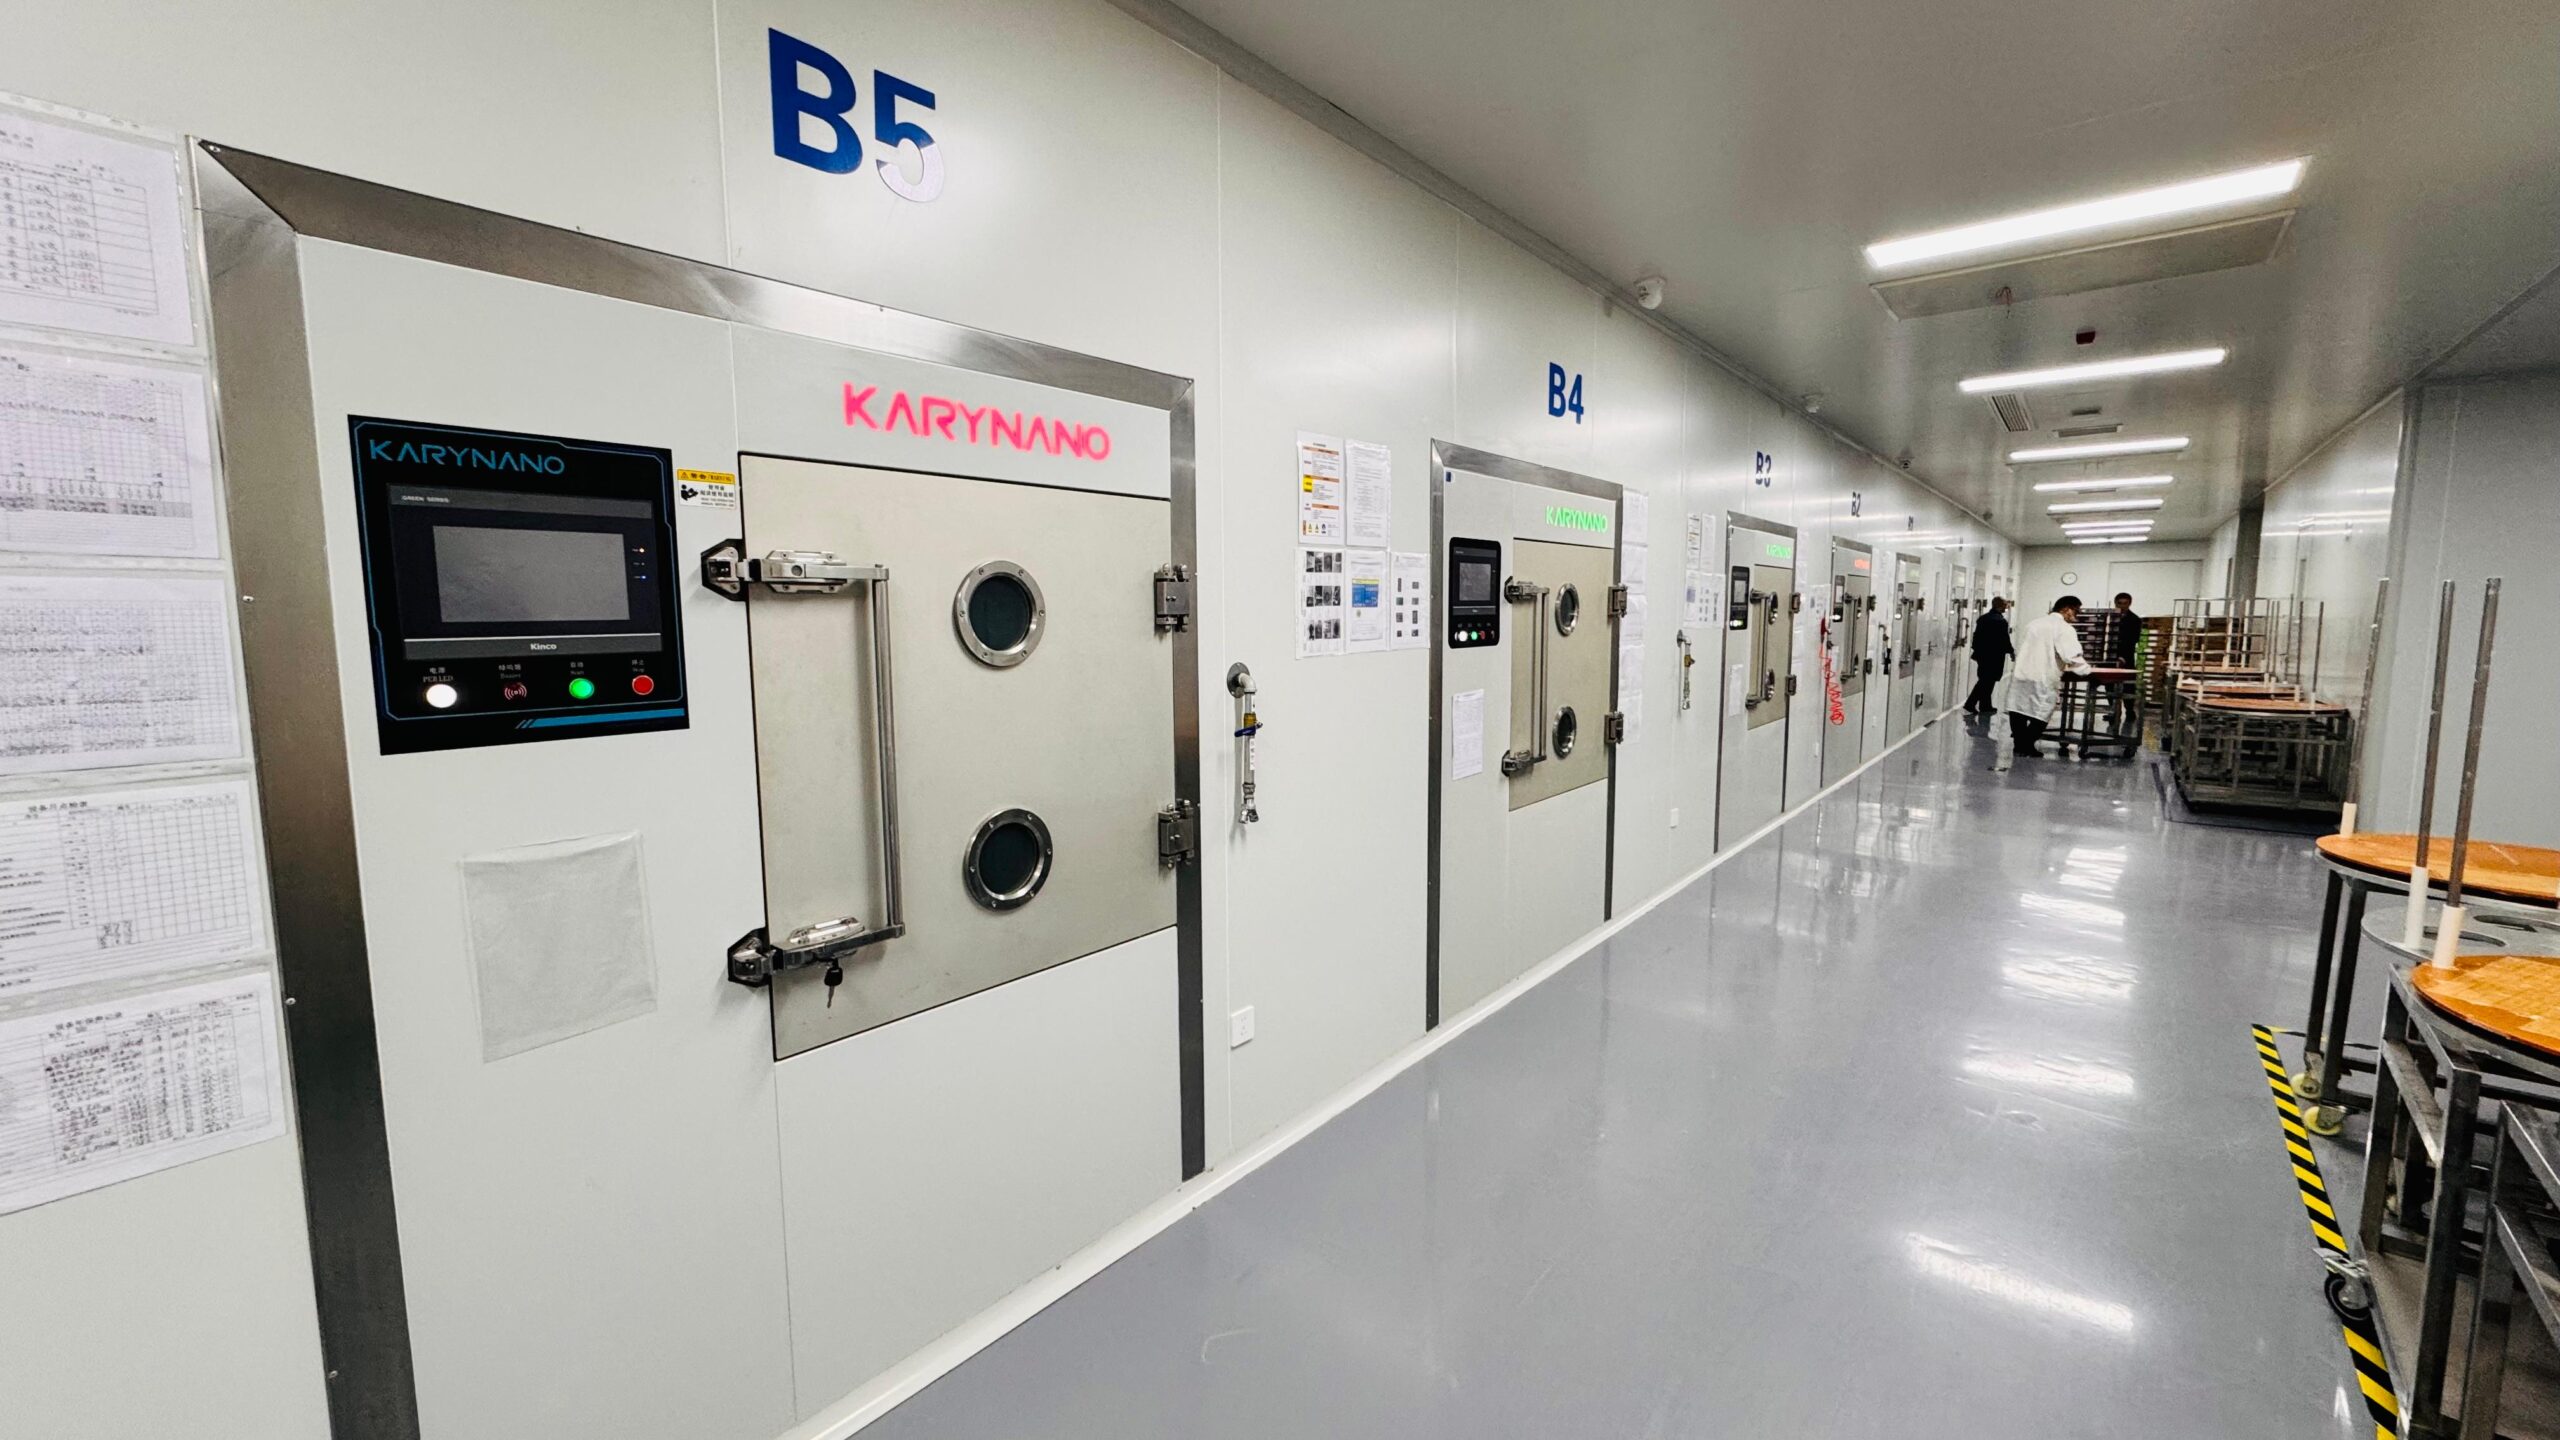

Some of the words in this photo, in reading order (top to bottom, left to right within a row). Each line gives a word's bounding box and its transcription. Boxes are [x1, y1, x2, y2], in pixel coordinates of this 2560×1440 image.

[767, 27, 945, 204] B5
[1548, 362, 1584, 424] B4
[843, 381, 1112, 462] KARYNANO
[369, 439, 565, 475] KARYNANO
[1546, 505, 1609, 533] KARYNANO
[1851, 491, 1862, 518] B2
